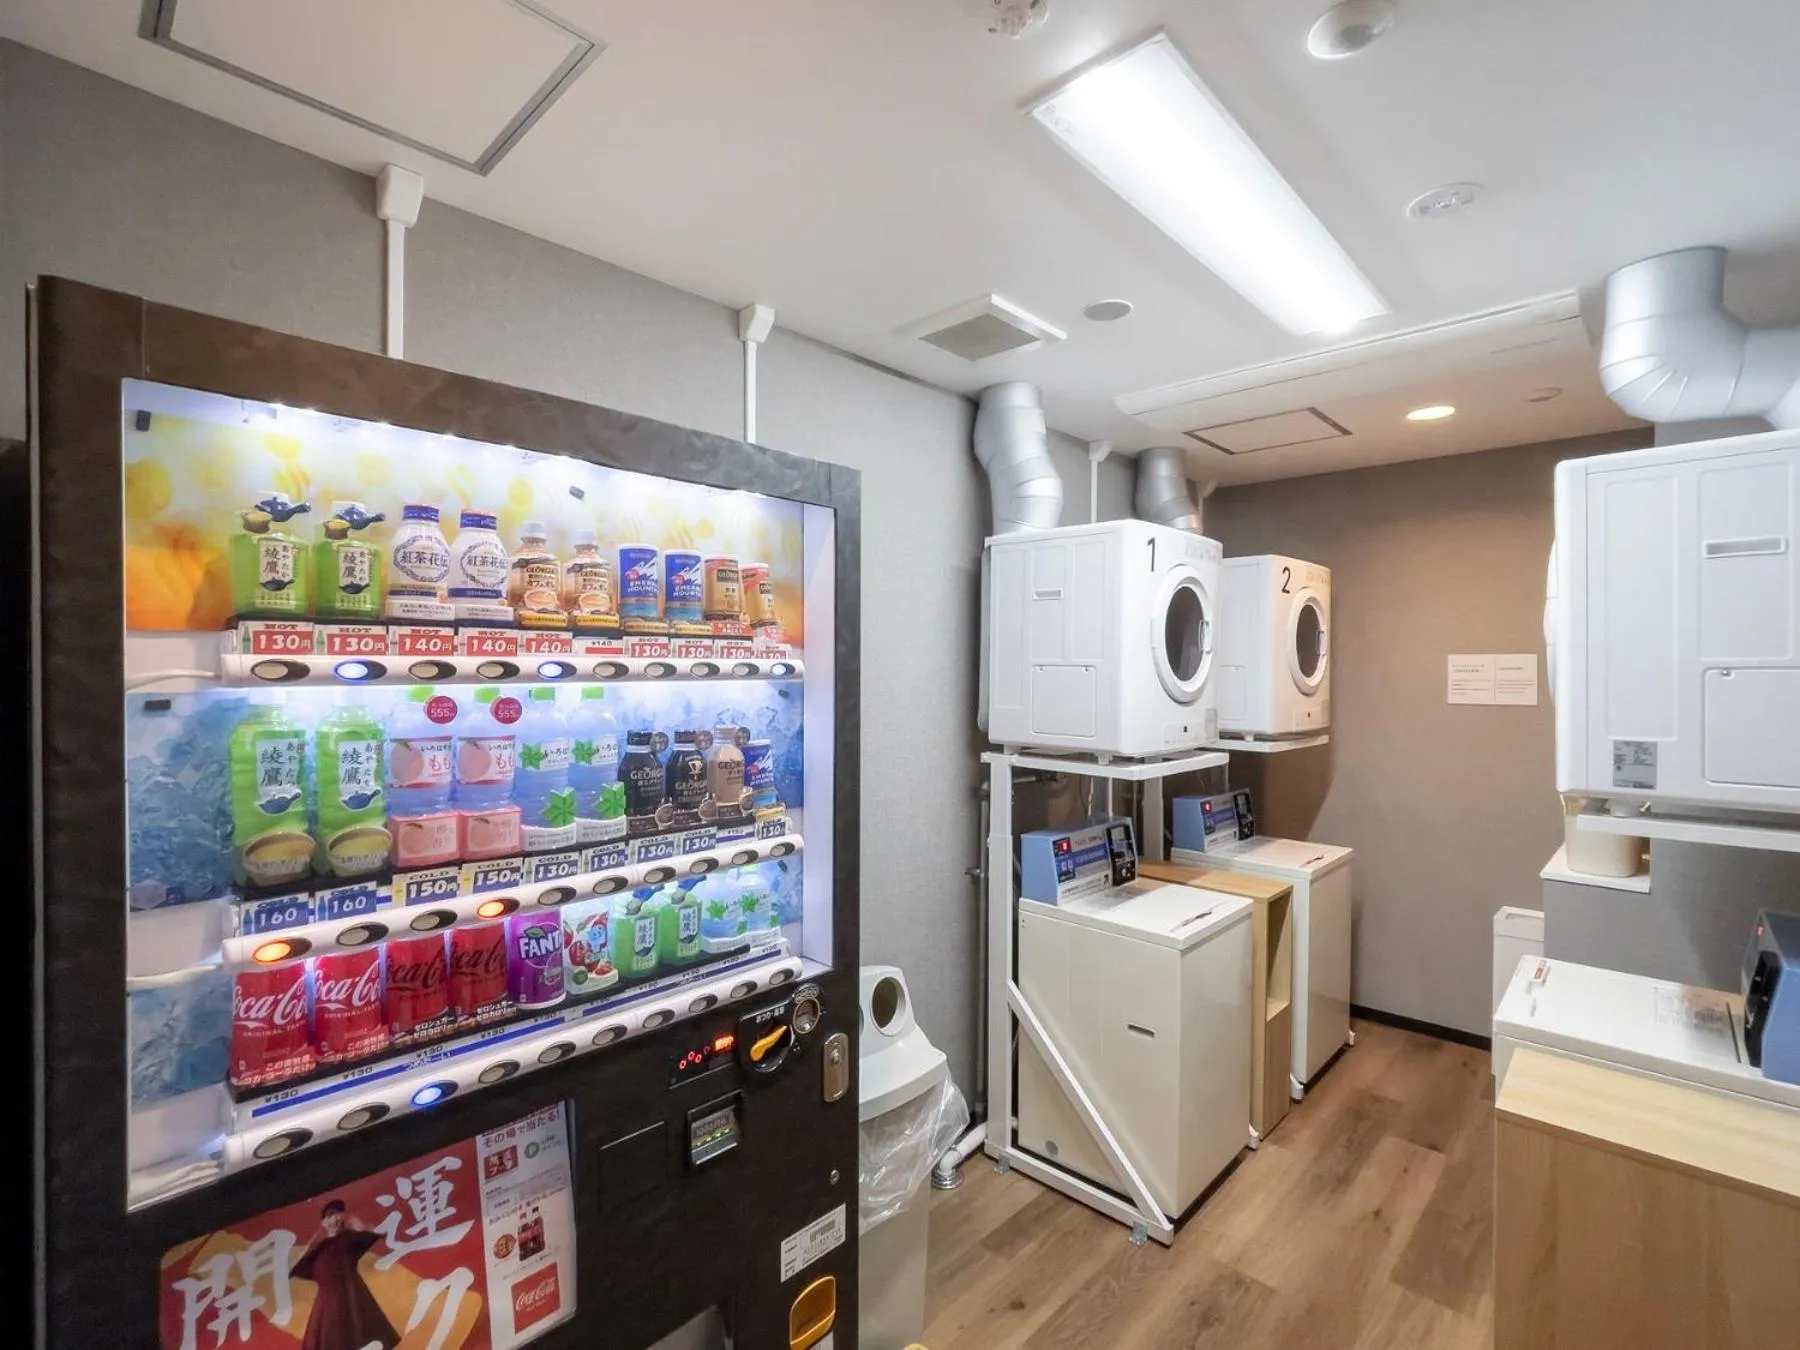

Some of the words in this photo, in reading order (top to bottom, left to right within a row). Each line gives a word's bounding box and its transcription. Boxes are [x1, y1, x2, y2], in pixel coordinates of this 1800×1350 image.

[1147, 537, 1156, 573] 1
[1281, 567, 1291, 594] 2
[477, 860, 516, 869] COLD
[409, 870, 450, 881] COLD
[332, 895, 368, 914] 160
[259, 907, 298, 927] 160
[343, 1066, 374, 1080] ¥130
[265, 1088, 299, 1103] ¥130
